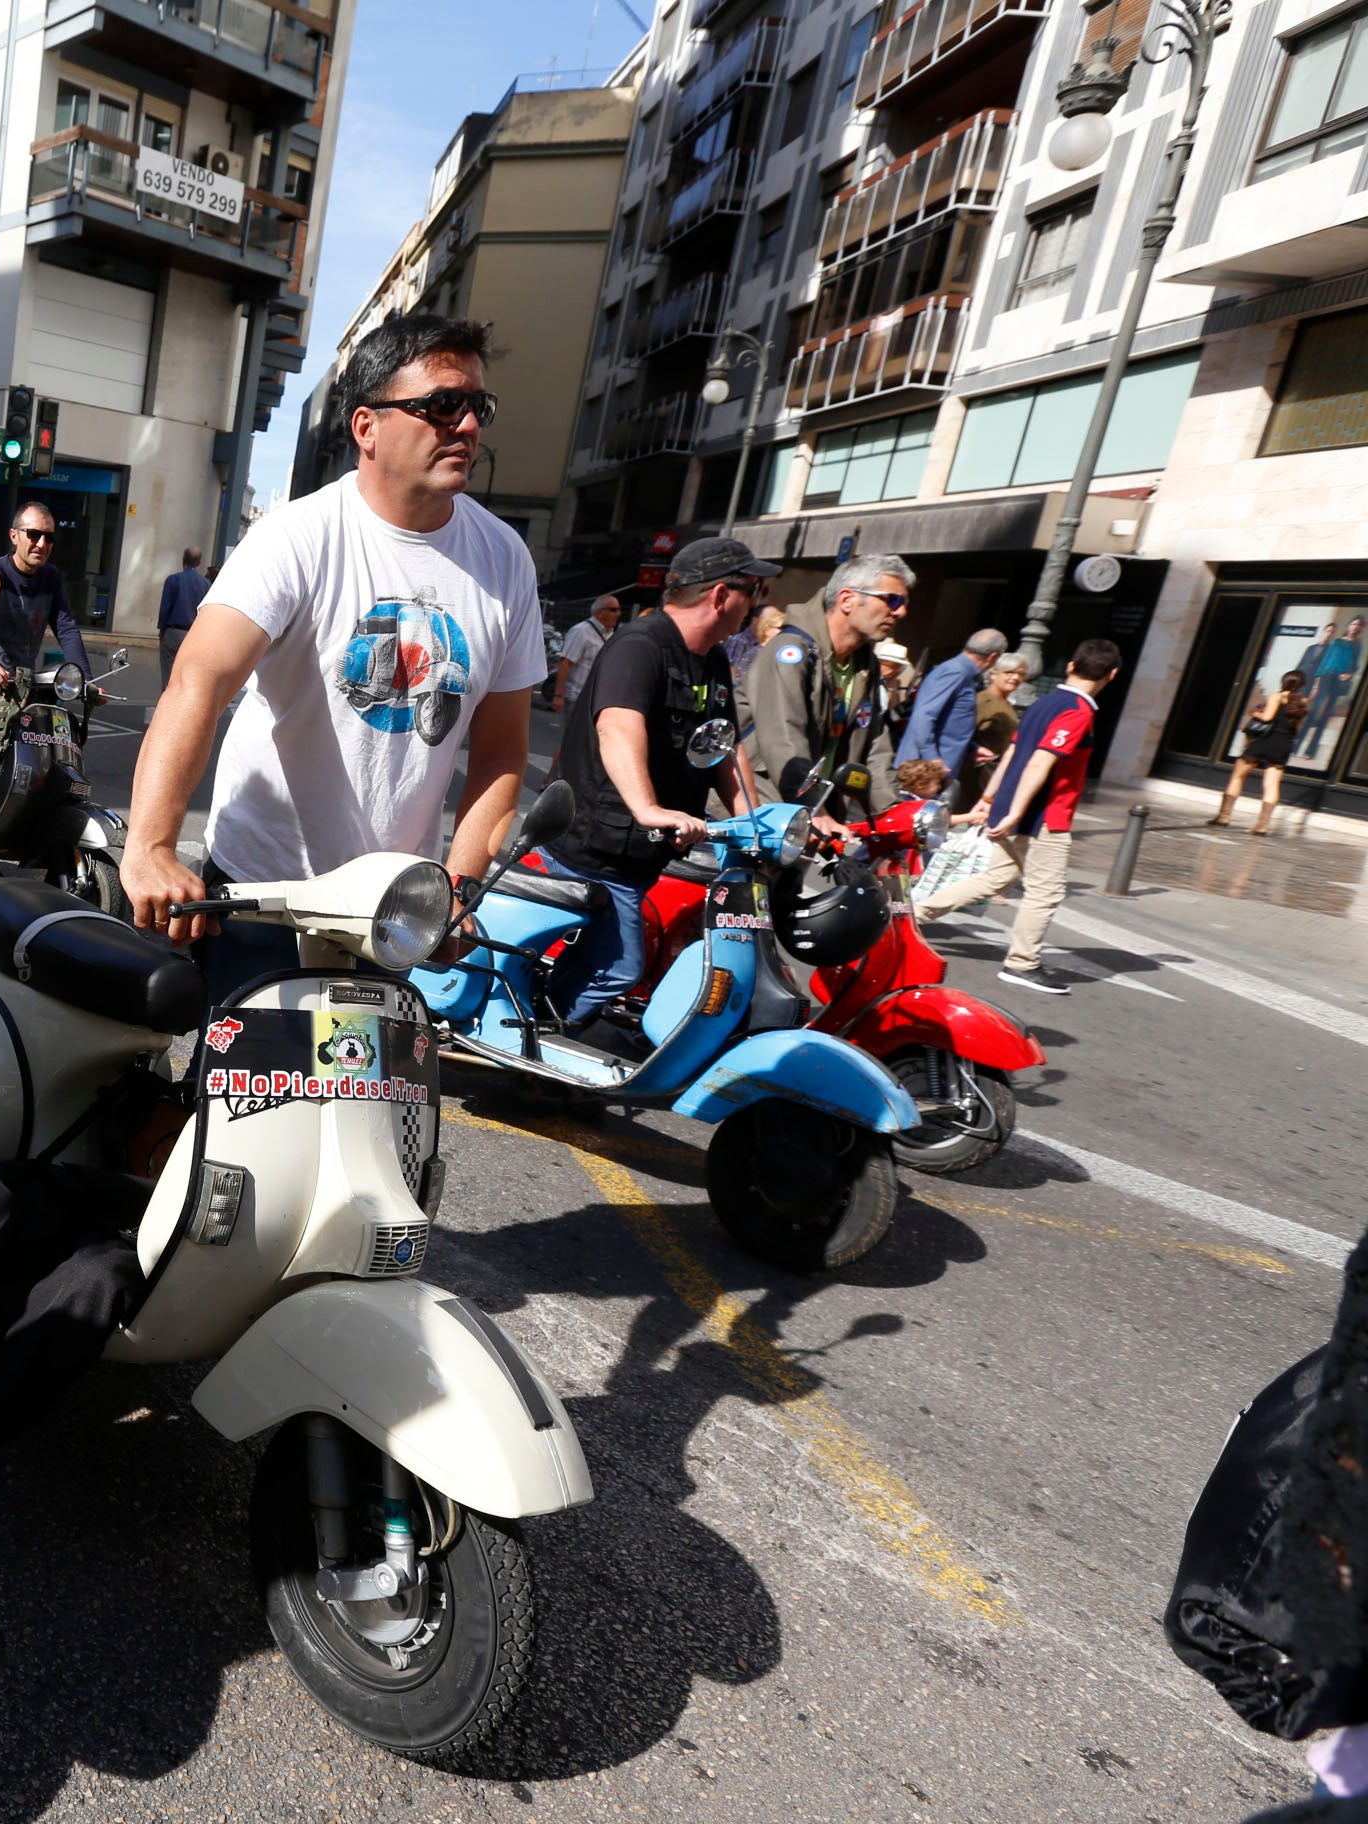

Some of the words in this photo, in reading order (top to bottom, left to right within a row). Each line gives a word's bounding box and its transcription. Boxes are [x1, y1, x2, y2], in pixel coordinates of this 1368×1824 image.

[172, 159, 215, 186] VENDO
[143, 169, 172, 193] 639
[176, 180, 205, 204] 579
[208, 192, 237, 216] 299
[653, 534, 674, 551] illy
[1051, 730, 1070, 747] 3
[336, 990, 381, 1000] MOTOVESPA
[340, 1057, 363, 1065] TERUEL
[206, 1068, 428, 1104] #NoPierdaselTren
